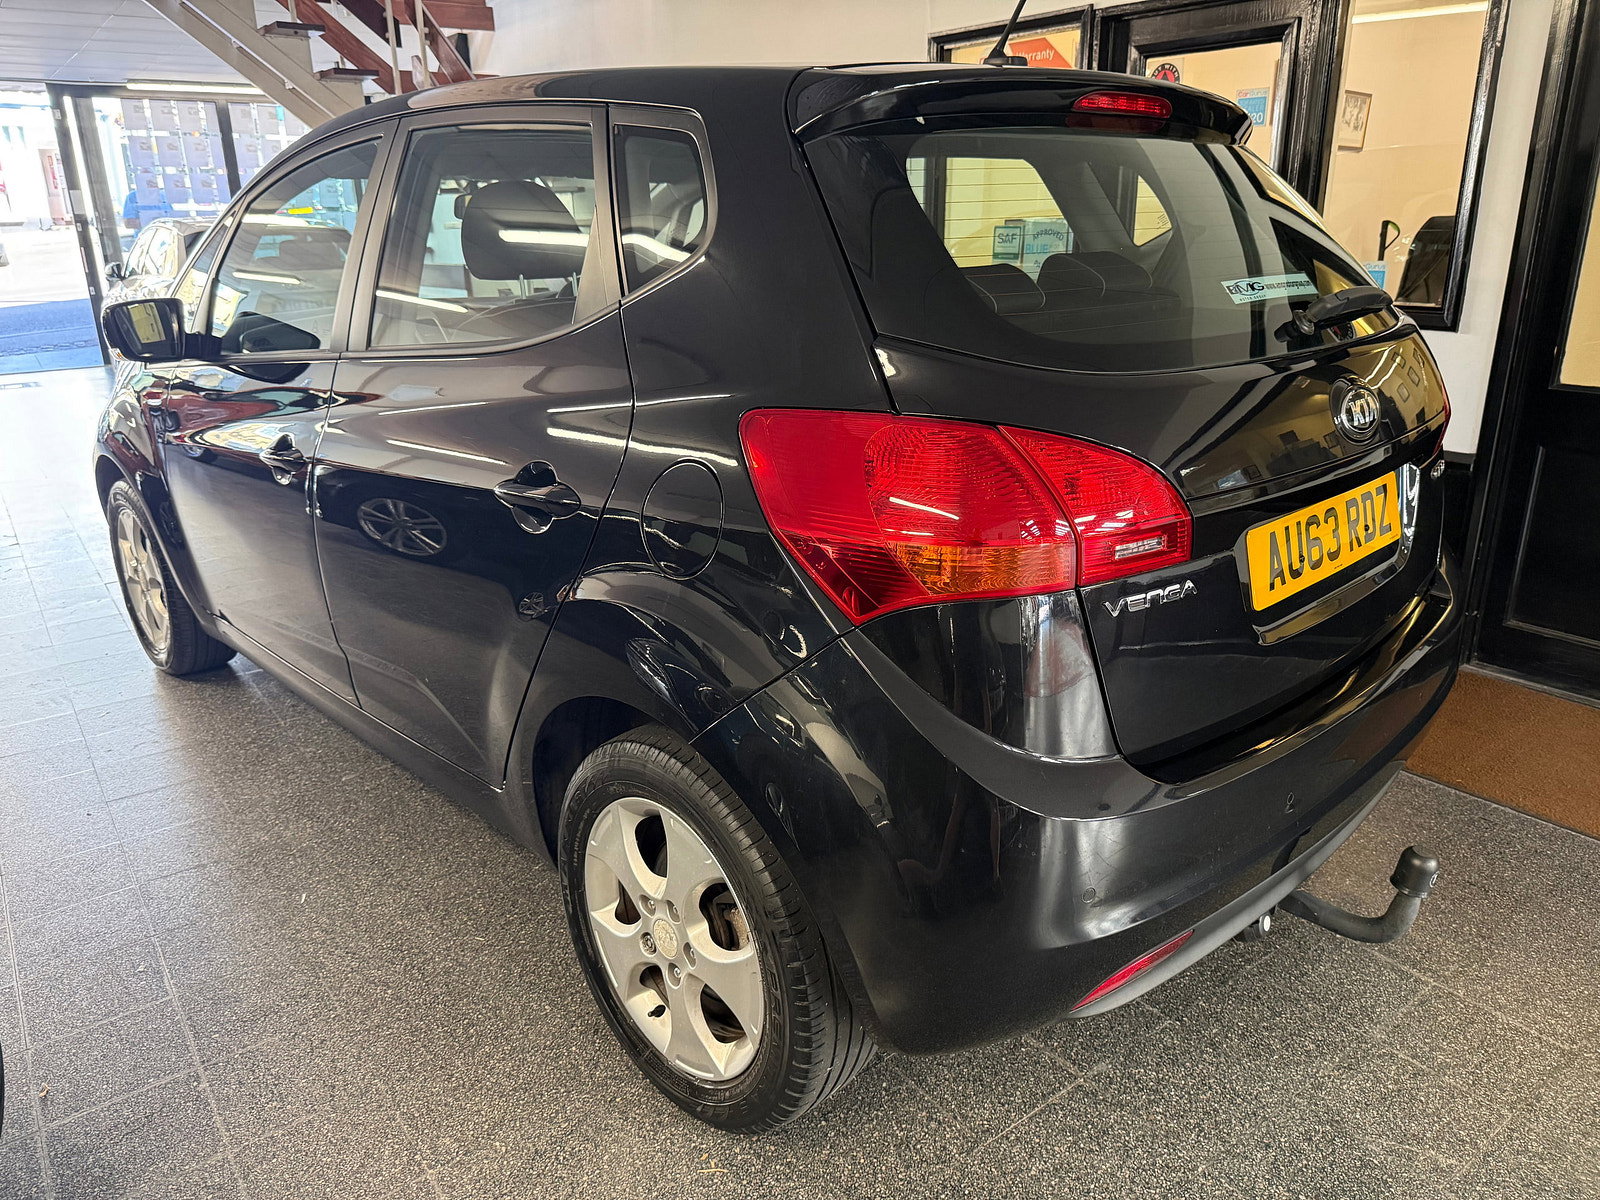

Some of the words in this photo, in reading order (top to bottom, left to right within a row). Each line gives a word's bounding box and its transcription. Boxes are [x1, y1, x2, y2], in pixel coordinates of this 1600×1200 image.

[1033, 228, 1064, 241] APPROVED
[1348, 396, 1377, 426] KIA
[1269, 507, 1341, 592] AU63
[1345, 483, 1392, 552] RDZ
[1102, 579, 1198, 618] VENGA
